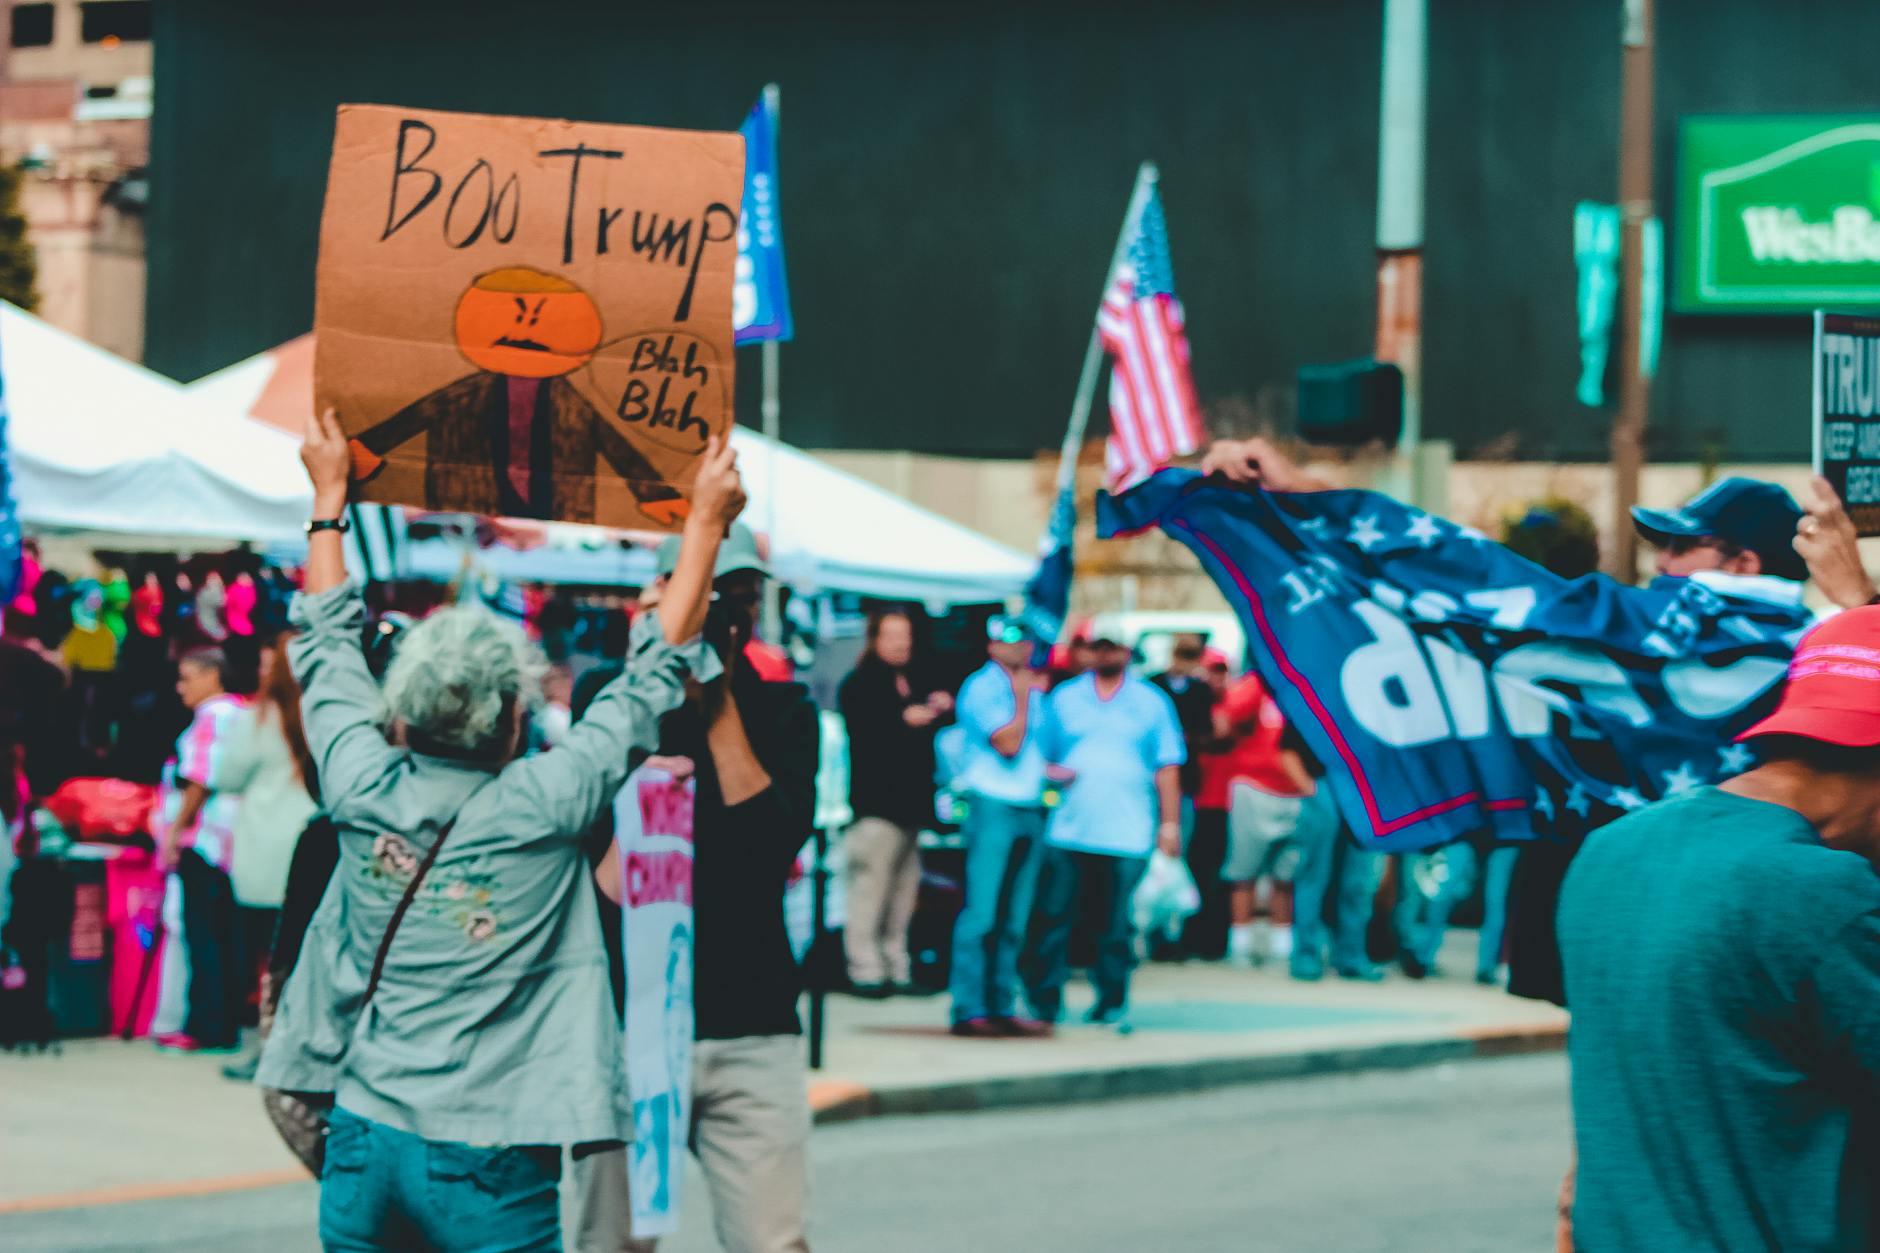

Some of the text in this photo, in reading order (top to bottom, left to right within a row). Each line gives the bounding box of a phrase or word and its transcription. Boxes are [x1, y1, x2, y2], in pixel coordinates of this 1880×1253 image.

[538, 142, 738, 323] Trump
[629, 336, 708, 387] Blah
[1823, 333, 1880, 418] TRU
[617, 380, 710, 442] Blah
